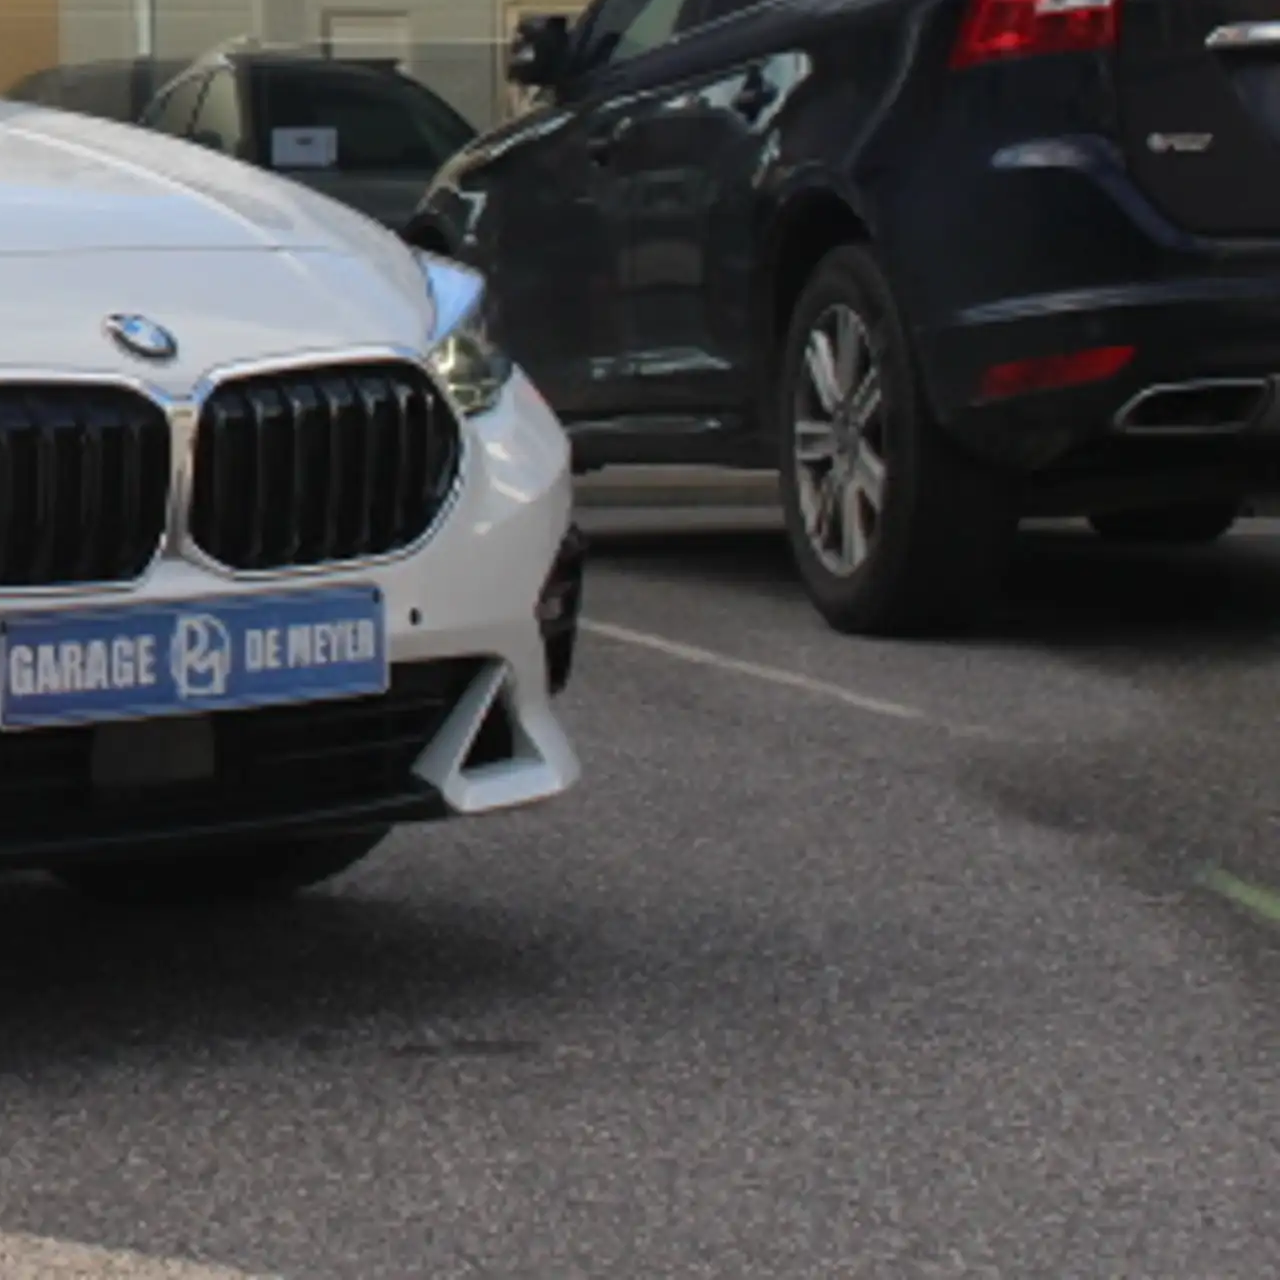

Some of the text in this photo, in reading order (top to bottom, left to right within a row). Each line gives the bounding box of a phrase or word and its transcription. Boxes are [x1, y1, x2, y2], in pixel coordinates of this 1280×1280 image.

[10, 634, 158, 696] GARAGE
[245, 627, 282, 674] DE
[287, 618, 376, 670] MEYER
